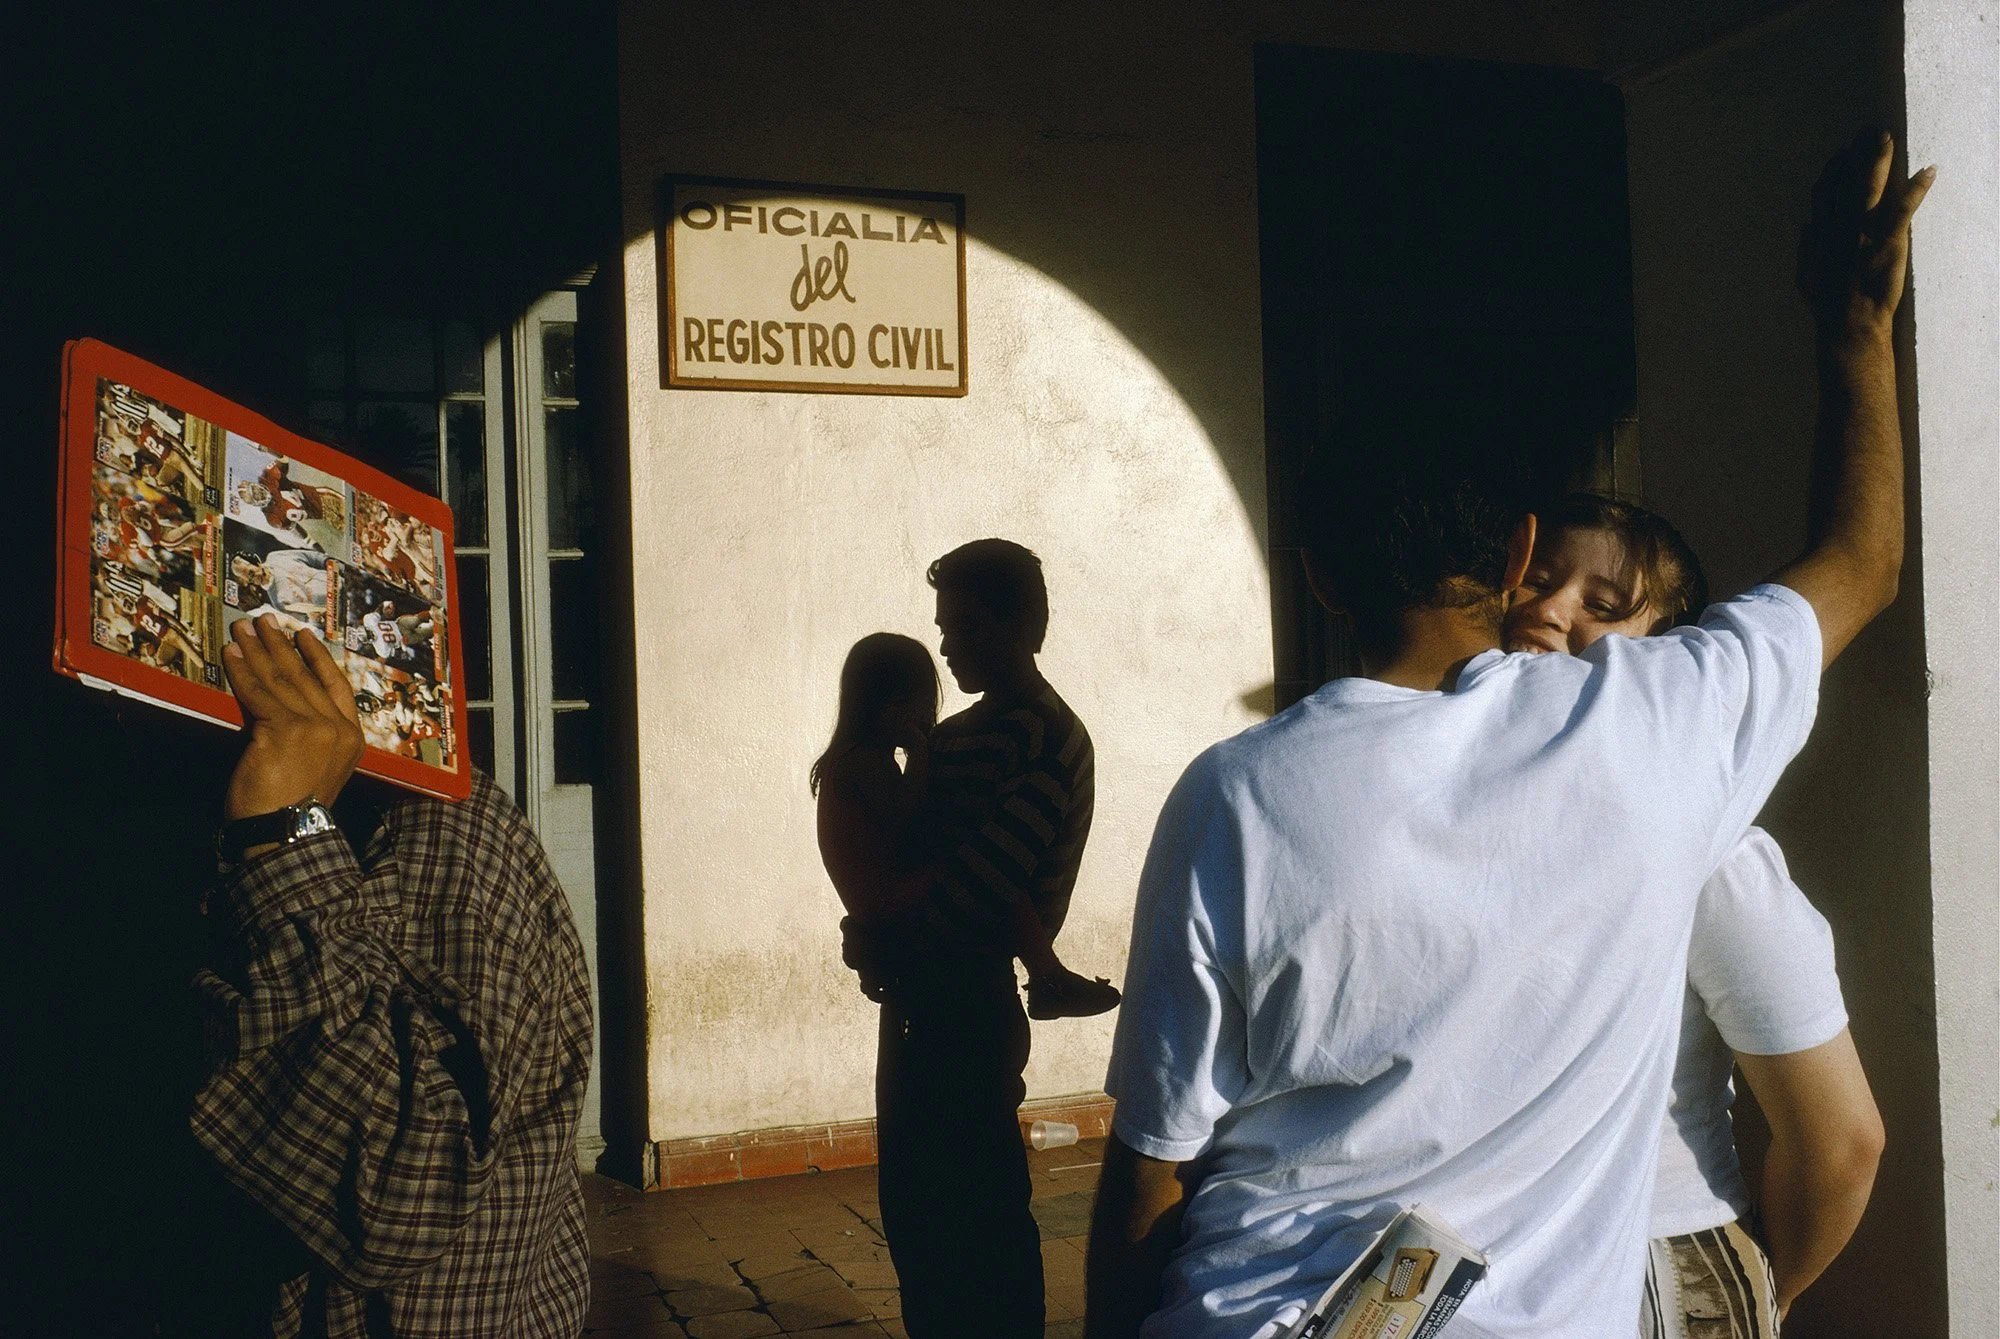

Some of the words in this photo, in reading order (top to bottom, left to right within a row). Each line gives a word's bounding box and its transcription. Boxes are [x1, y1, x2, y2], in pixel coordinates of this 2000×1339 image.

[680, 200, 948, 245] OFICIALIA
[790, 240, 856, 312] del
[683, 317, 856, 369] REGISTRO
[868, 323, 954, 371] CIVIL
[1429, 1312, 1438, 1320] LA
[1433, 1296, 1455, 1327] SEMANAS
[1434, 1294, 1449, 1311] TODA
